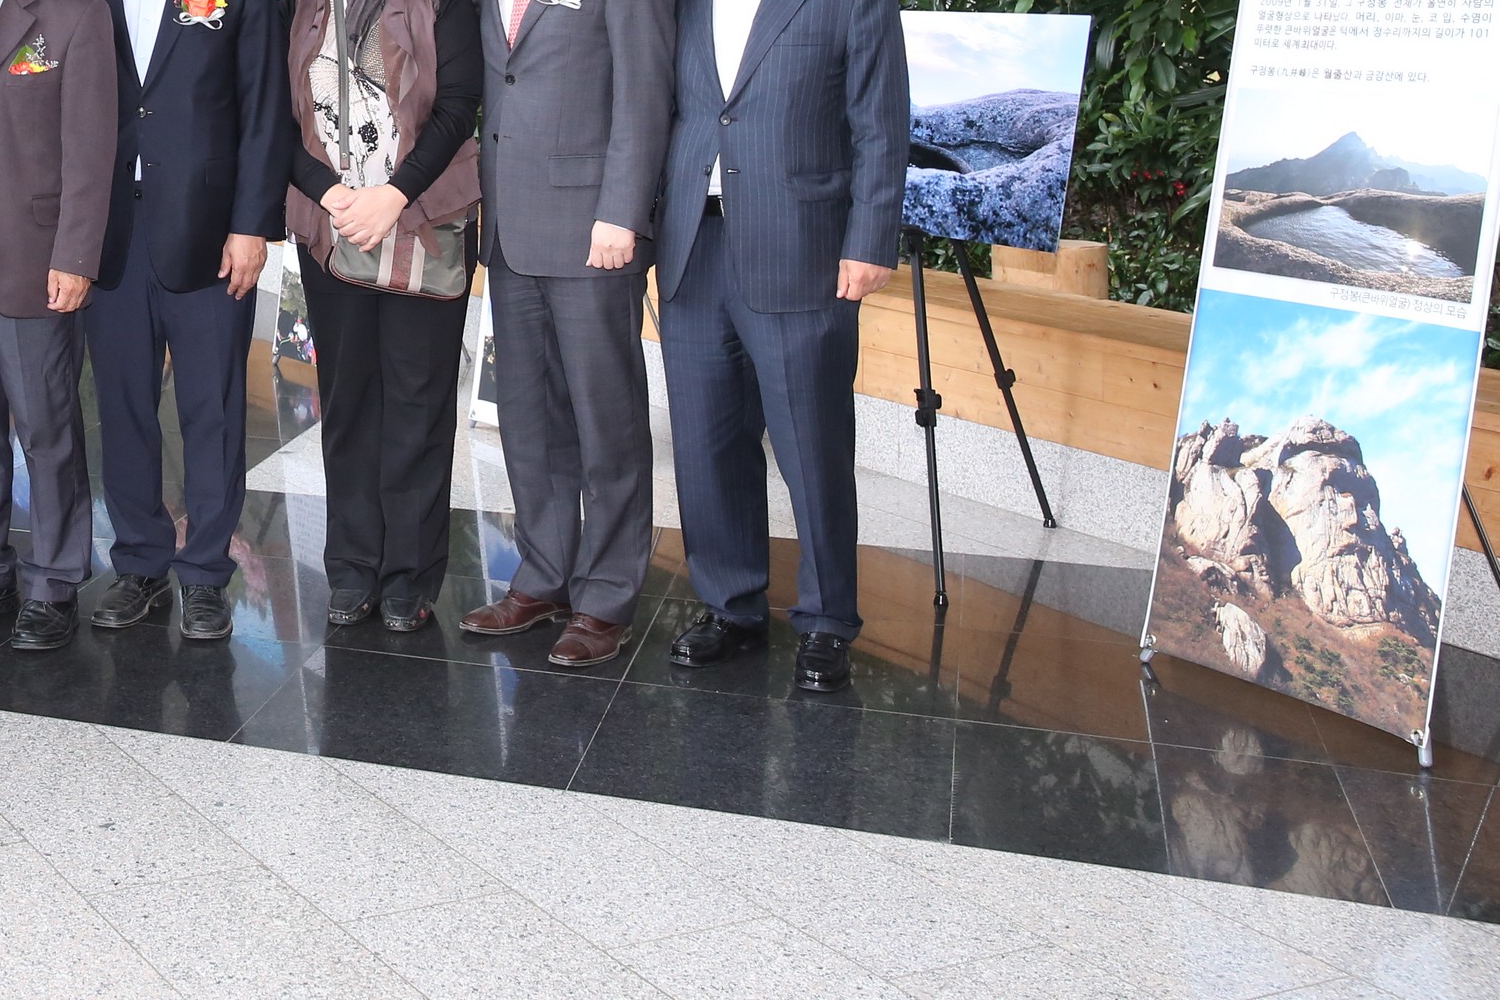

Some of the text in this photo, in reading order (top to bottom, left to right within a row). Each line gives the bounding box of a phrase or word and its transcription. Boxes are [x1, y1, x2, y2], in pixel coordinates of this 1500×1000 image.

[1258, 10, 1310, 21] 얼굴형상으로
[1460, 12, 1492, 23] 수염이
[1256, 24, 1489, 39] 뚜렷한 큰바위얼굴은 턱에서 정수리까지의 길이가 101
[1253, 38, 1337, 50] 미터로 세계최대이다.
[1324, 68, 1362, 80] 월출산과
[1366, 70, 1403, 82] 금강산에
[1407, 71, 1430, 83] 있다.
[1330, 287, 1468, 319] 구정봉(큰바위얼굴) 정상의 모습
